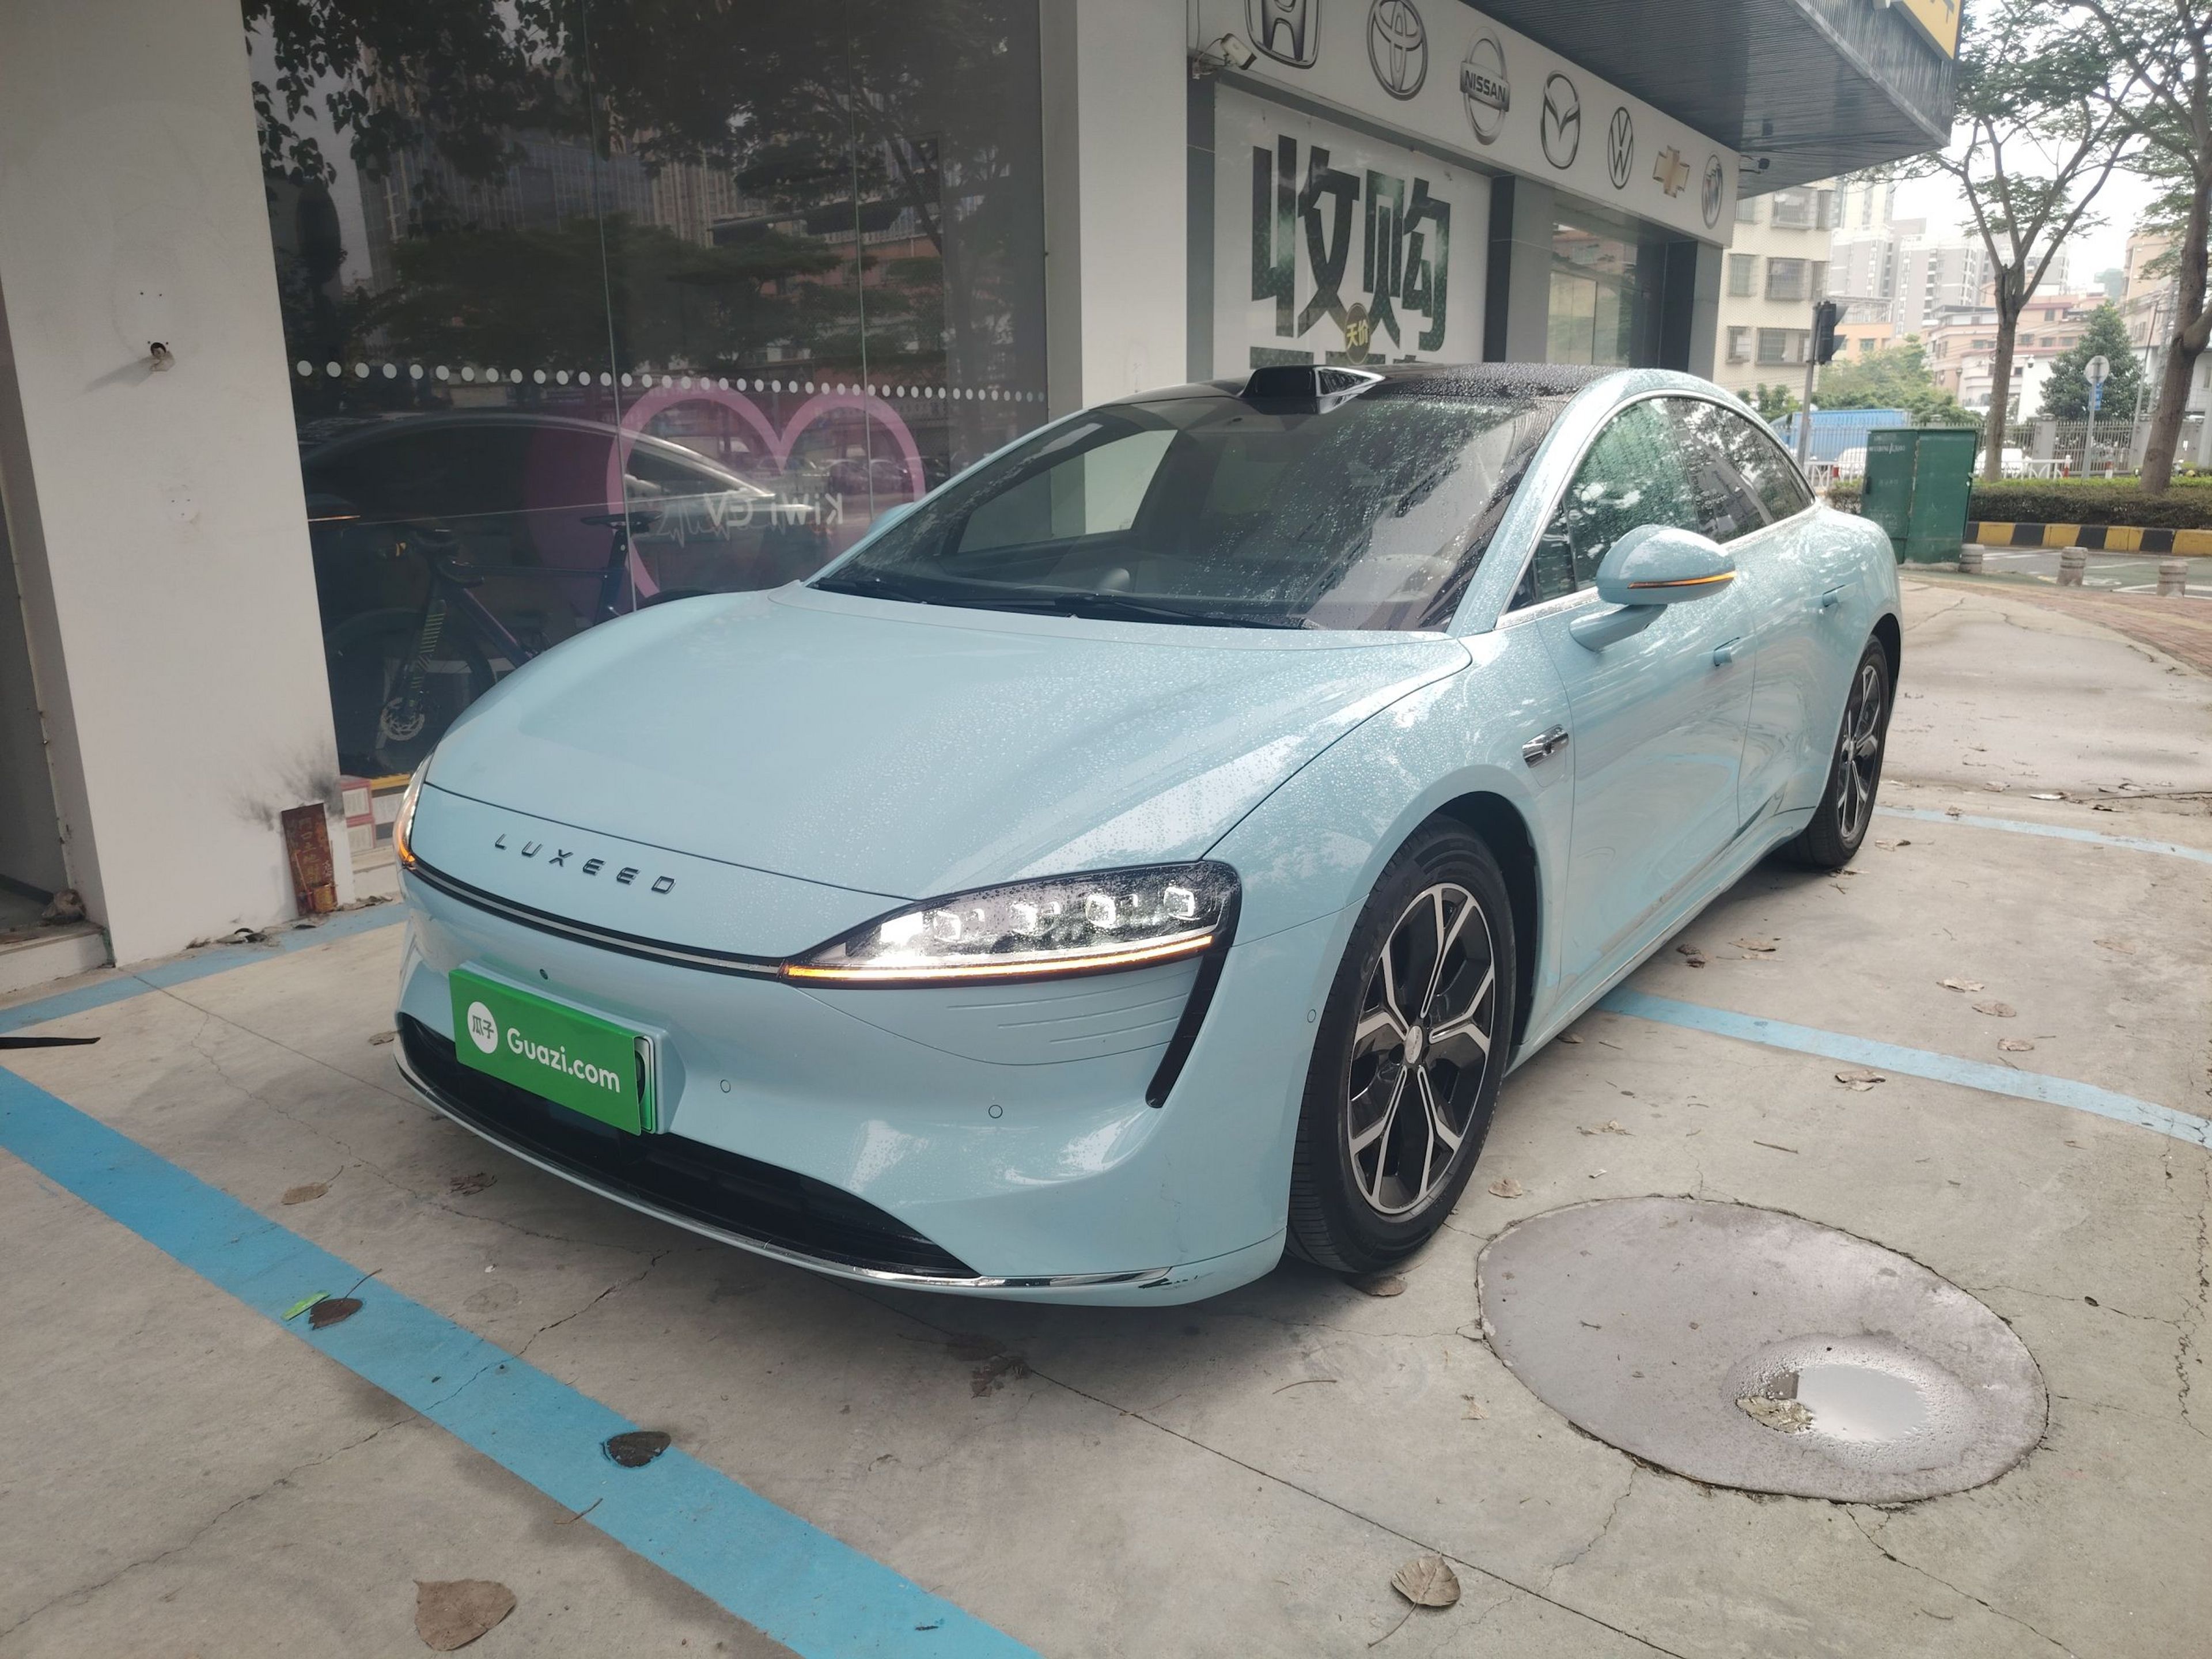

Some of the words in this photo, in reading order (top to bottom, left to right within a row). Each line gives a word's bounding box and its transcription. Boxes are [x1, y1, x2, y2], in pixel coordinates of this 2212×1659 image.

[1465, 70, 1506, 103] NISSAN
[1251, 134, 1451, 352] 收购
[1346, 320, 1369, 349] 天价
[494, 833, 676, 894] LUXEED
[471, 1014, 495, 1040] 瓜子
[506, 1028, 620, 1093] Guazi.com
